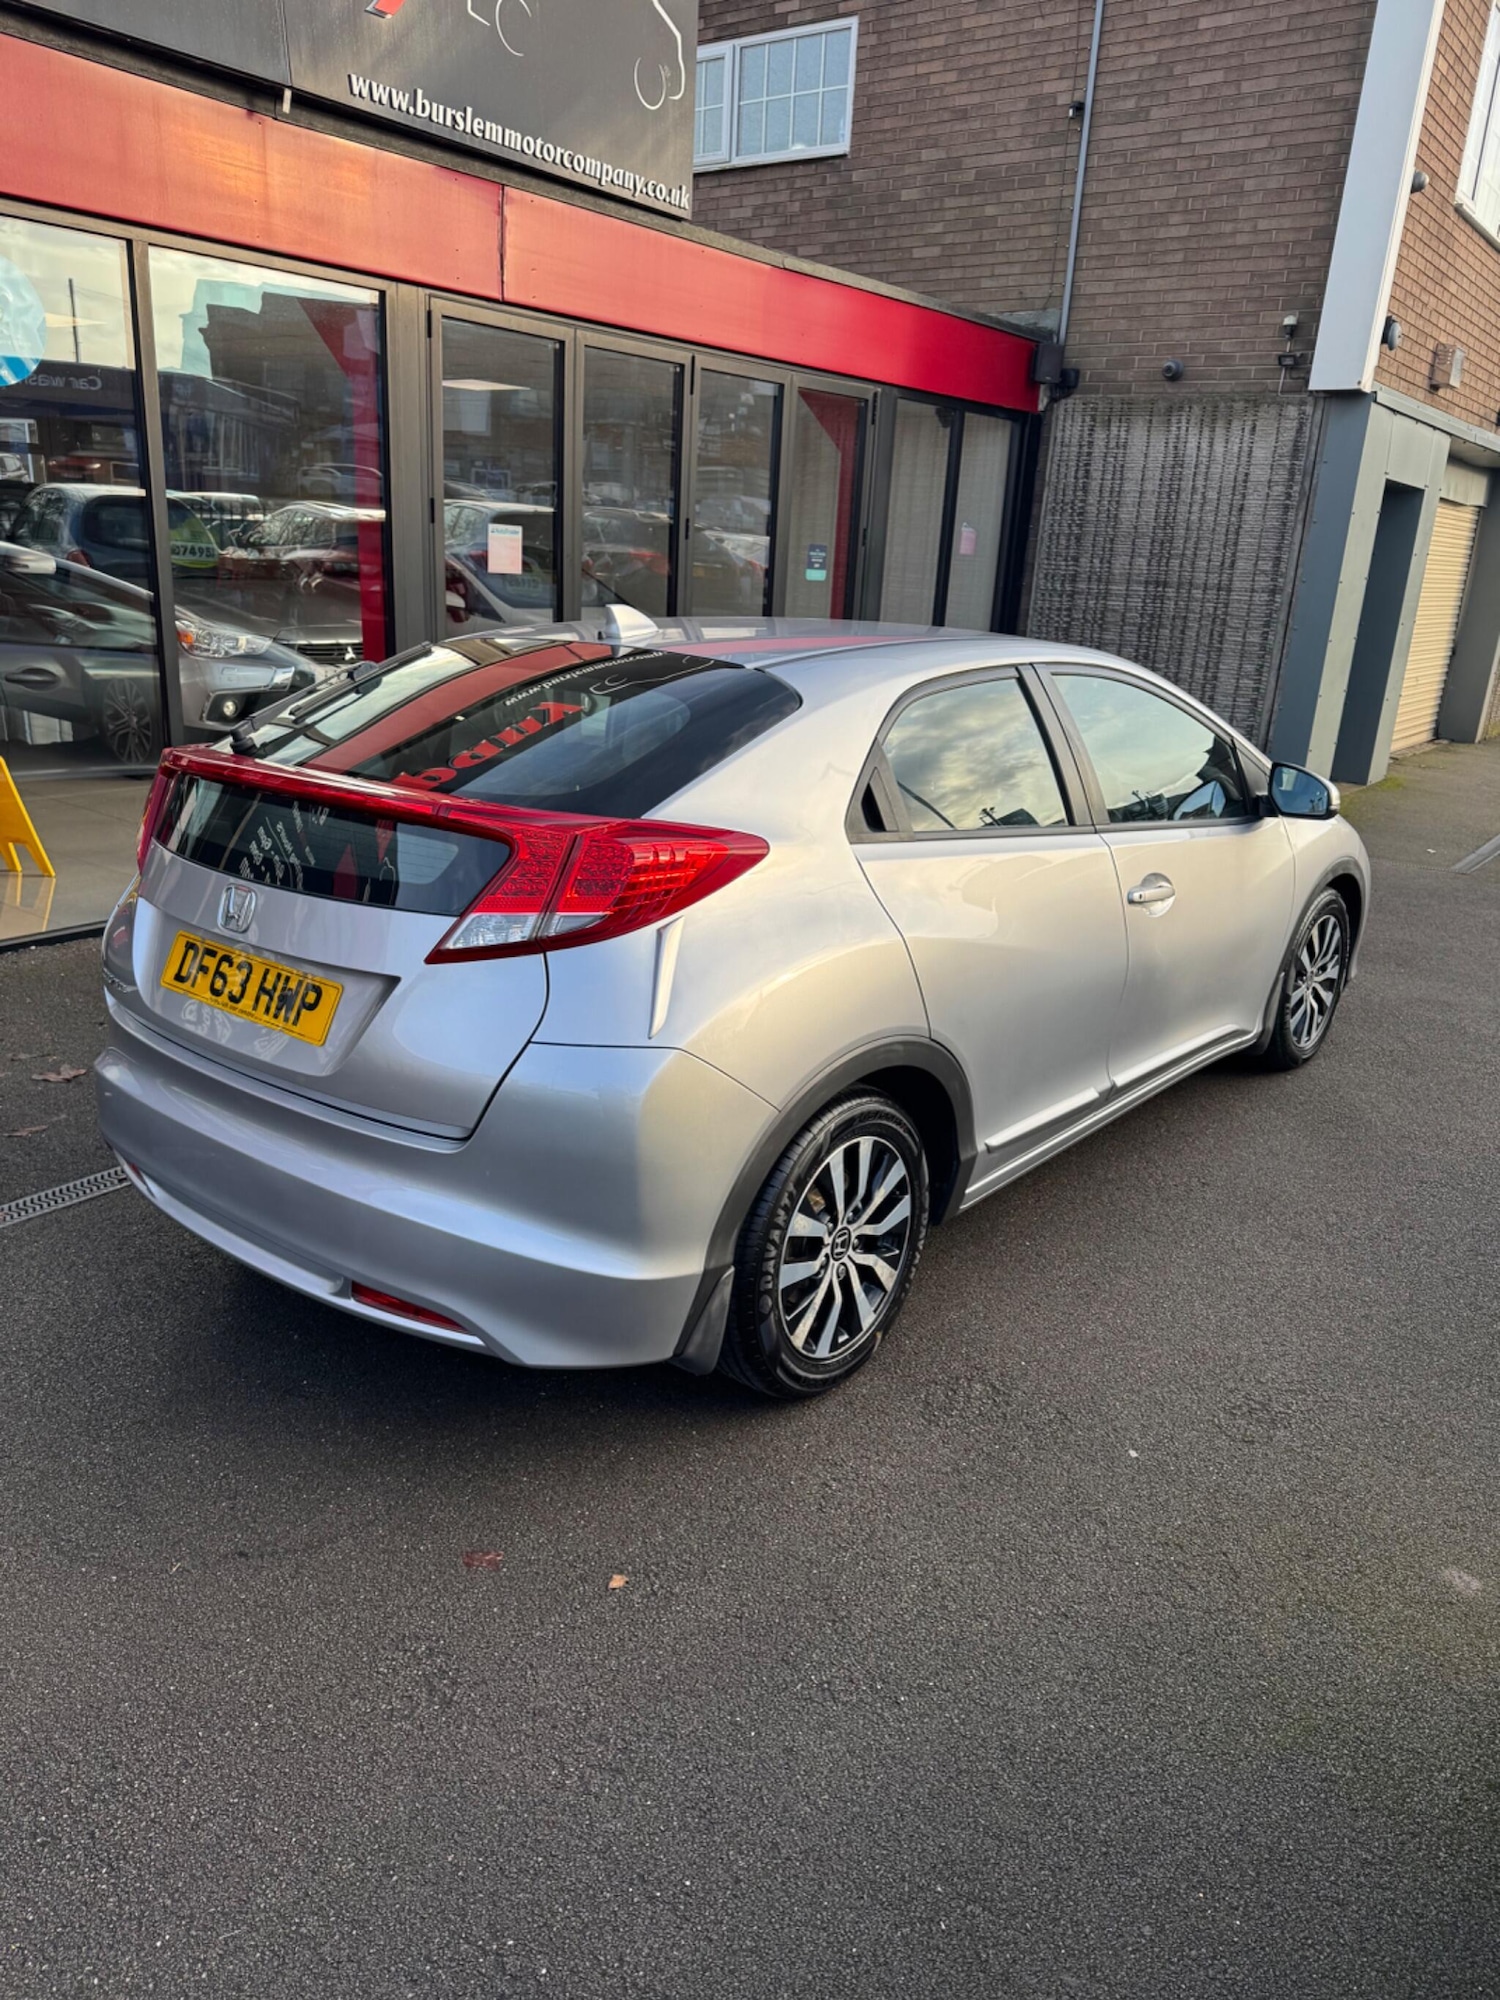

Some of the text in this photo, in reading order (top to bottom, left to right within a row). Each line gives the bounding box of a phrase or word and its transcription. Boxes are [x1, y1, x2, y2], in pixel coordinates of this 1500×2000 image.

[348, 73, 690, 210] www.burslemmotorcompany.co.uk
[173, 940, 253, 1004] DF63
[252, 967, 323, 1027] HWP
